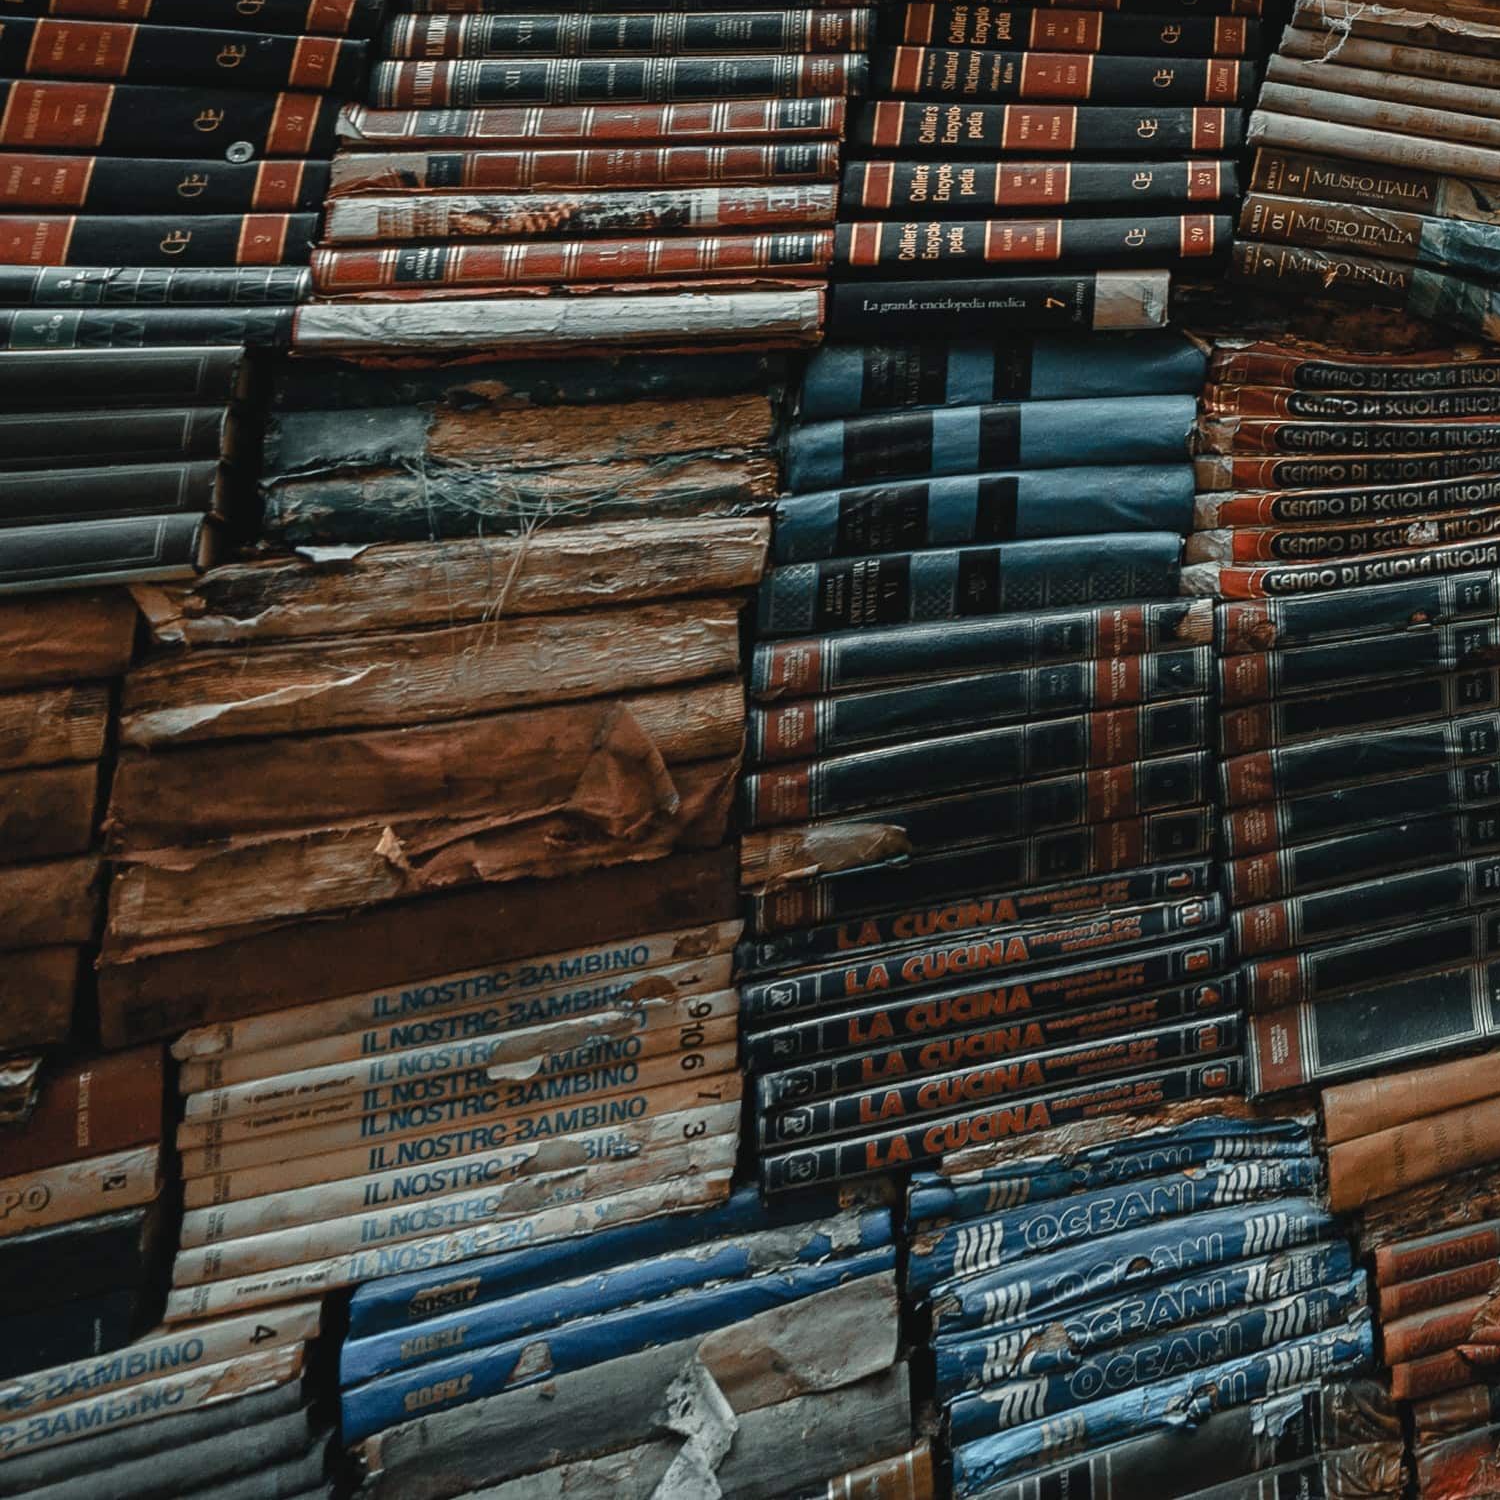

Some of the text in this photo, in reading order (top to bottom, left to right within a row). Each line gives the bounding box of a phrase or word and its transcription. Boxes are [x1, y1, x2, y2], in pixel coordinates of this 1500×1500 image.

[517, 20, 533, 43] XIII
[947, 5, 969, 44] Collier's
[995, 12, 1012, 40] pedia
[505, 71, 521, 90] XII
[941, 51, 960, 90] Standard
[963, 50, 985, 93] Dictionary
[1216, 67, 1229, 93] Collier
[918, 106, 939, 143] Collier's
[967, 111, 984, 138] pedia
[1204, 122, 1216, 135] 18
[910, 164, 929, 202] Collier's
[960, 168, 976, 195] pedia
[1288, 173, 1300, 183] 5
[1312, 170, 1429, 200] MUSEO ITALIA
[1190, 227, 1204, 242] 20
[1271, 213, 1285, 230] 10
[1296, 214, 1359, 237] MUSEO
[1362, 226, 1413, 245] ITALIA
[898, 223, 918, 260] Collier's
[947, 227, 966, 253] pedia
[1263, 258, 1276, 267] 6
[1288, 255, 1405, 288] MUSEO ITALIA
[863, 297, 1026, 313] La grande enciclopedia medica
[1045, 297, 1066, 308] 7
[1303, 368, 1365, 387] TEMPO
[1371, 372, 1387, 388] DI
[1391, 370, 1456, 388] SCUOLA
[1295, 397, 1359, 415] TEMPO
[1362, 400, 1381, 414] DI
[1385, 398, 1450, 415] SCUOLA
[1283, 429, 1347, 446] TEMPO
[1354, 431, 1369, 447] DI
[1374, 431, 1440, 447] SCUOLA
[1281, 461, 1345, 482] TEMPO
[1351, 463, 1369, 480] DI
[1373, 462, 1440, 479] SCUOLA
[1280, 499, 1345, 516] TEMPO
[1350, 498, 1367, 512] DI
[1373, 489, 1438, 510] SCUOLA
[1280, 535, 1345, 555] TEMPO
[1350, 535, 1368, 549] DI
[1271, 569, 1337, 592] TEMPO
[1342, 566, 1360, 583] DI
[1365, 559, 1431, 579] SCUOLA
[866, 559, 881, 622] UNIVERSALE
[837, 899, 1018, 951] LA CUCINA
[844, 935, 1030, 998] LA CUCINA
[372, 995, 398, 1020] IL
[693, 998, 714, 1020] 9
[848, 985, 1033, 1045] LA CUCINA
[361, 1030, 386, 1055] IL
[680, 1022, 707, 1048] 10
[679, 1051, 705, 1072] 6
[861, 1023, 1046, 1082] LA CUCINA
[367, 1060, 393, 1085] IL
[361, 1086, 386, 1111] IL
[859, 1060, 1046, 1124] LA CUCINA
[360, 1112, 386, 1137] IL
[682, 1119, 707, 1141] 3
[865, 1100, 1052, 1170] LA CUCINA
[368, 1147, 394, 1171] IL
[363, 1182, 388, 1205] IL
[1024, 1180, 1197, 1250] OCEANI
[360, 1217, 386, 1245] IL
[249, 1324, 277, 1343] 4
[43, 1338, 205, 1398] BAMBINO
[1069, 1322, 1242, 1400] OCEANI
